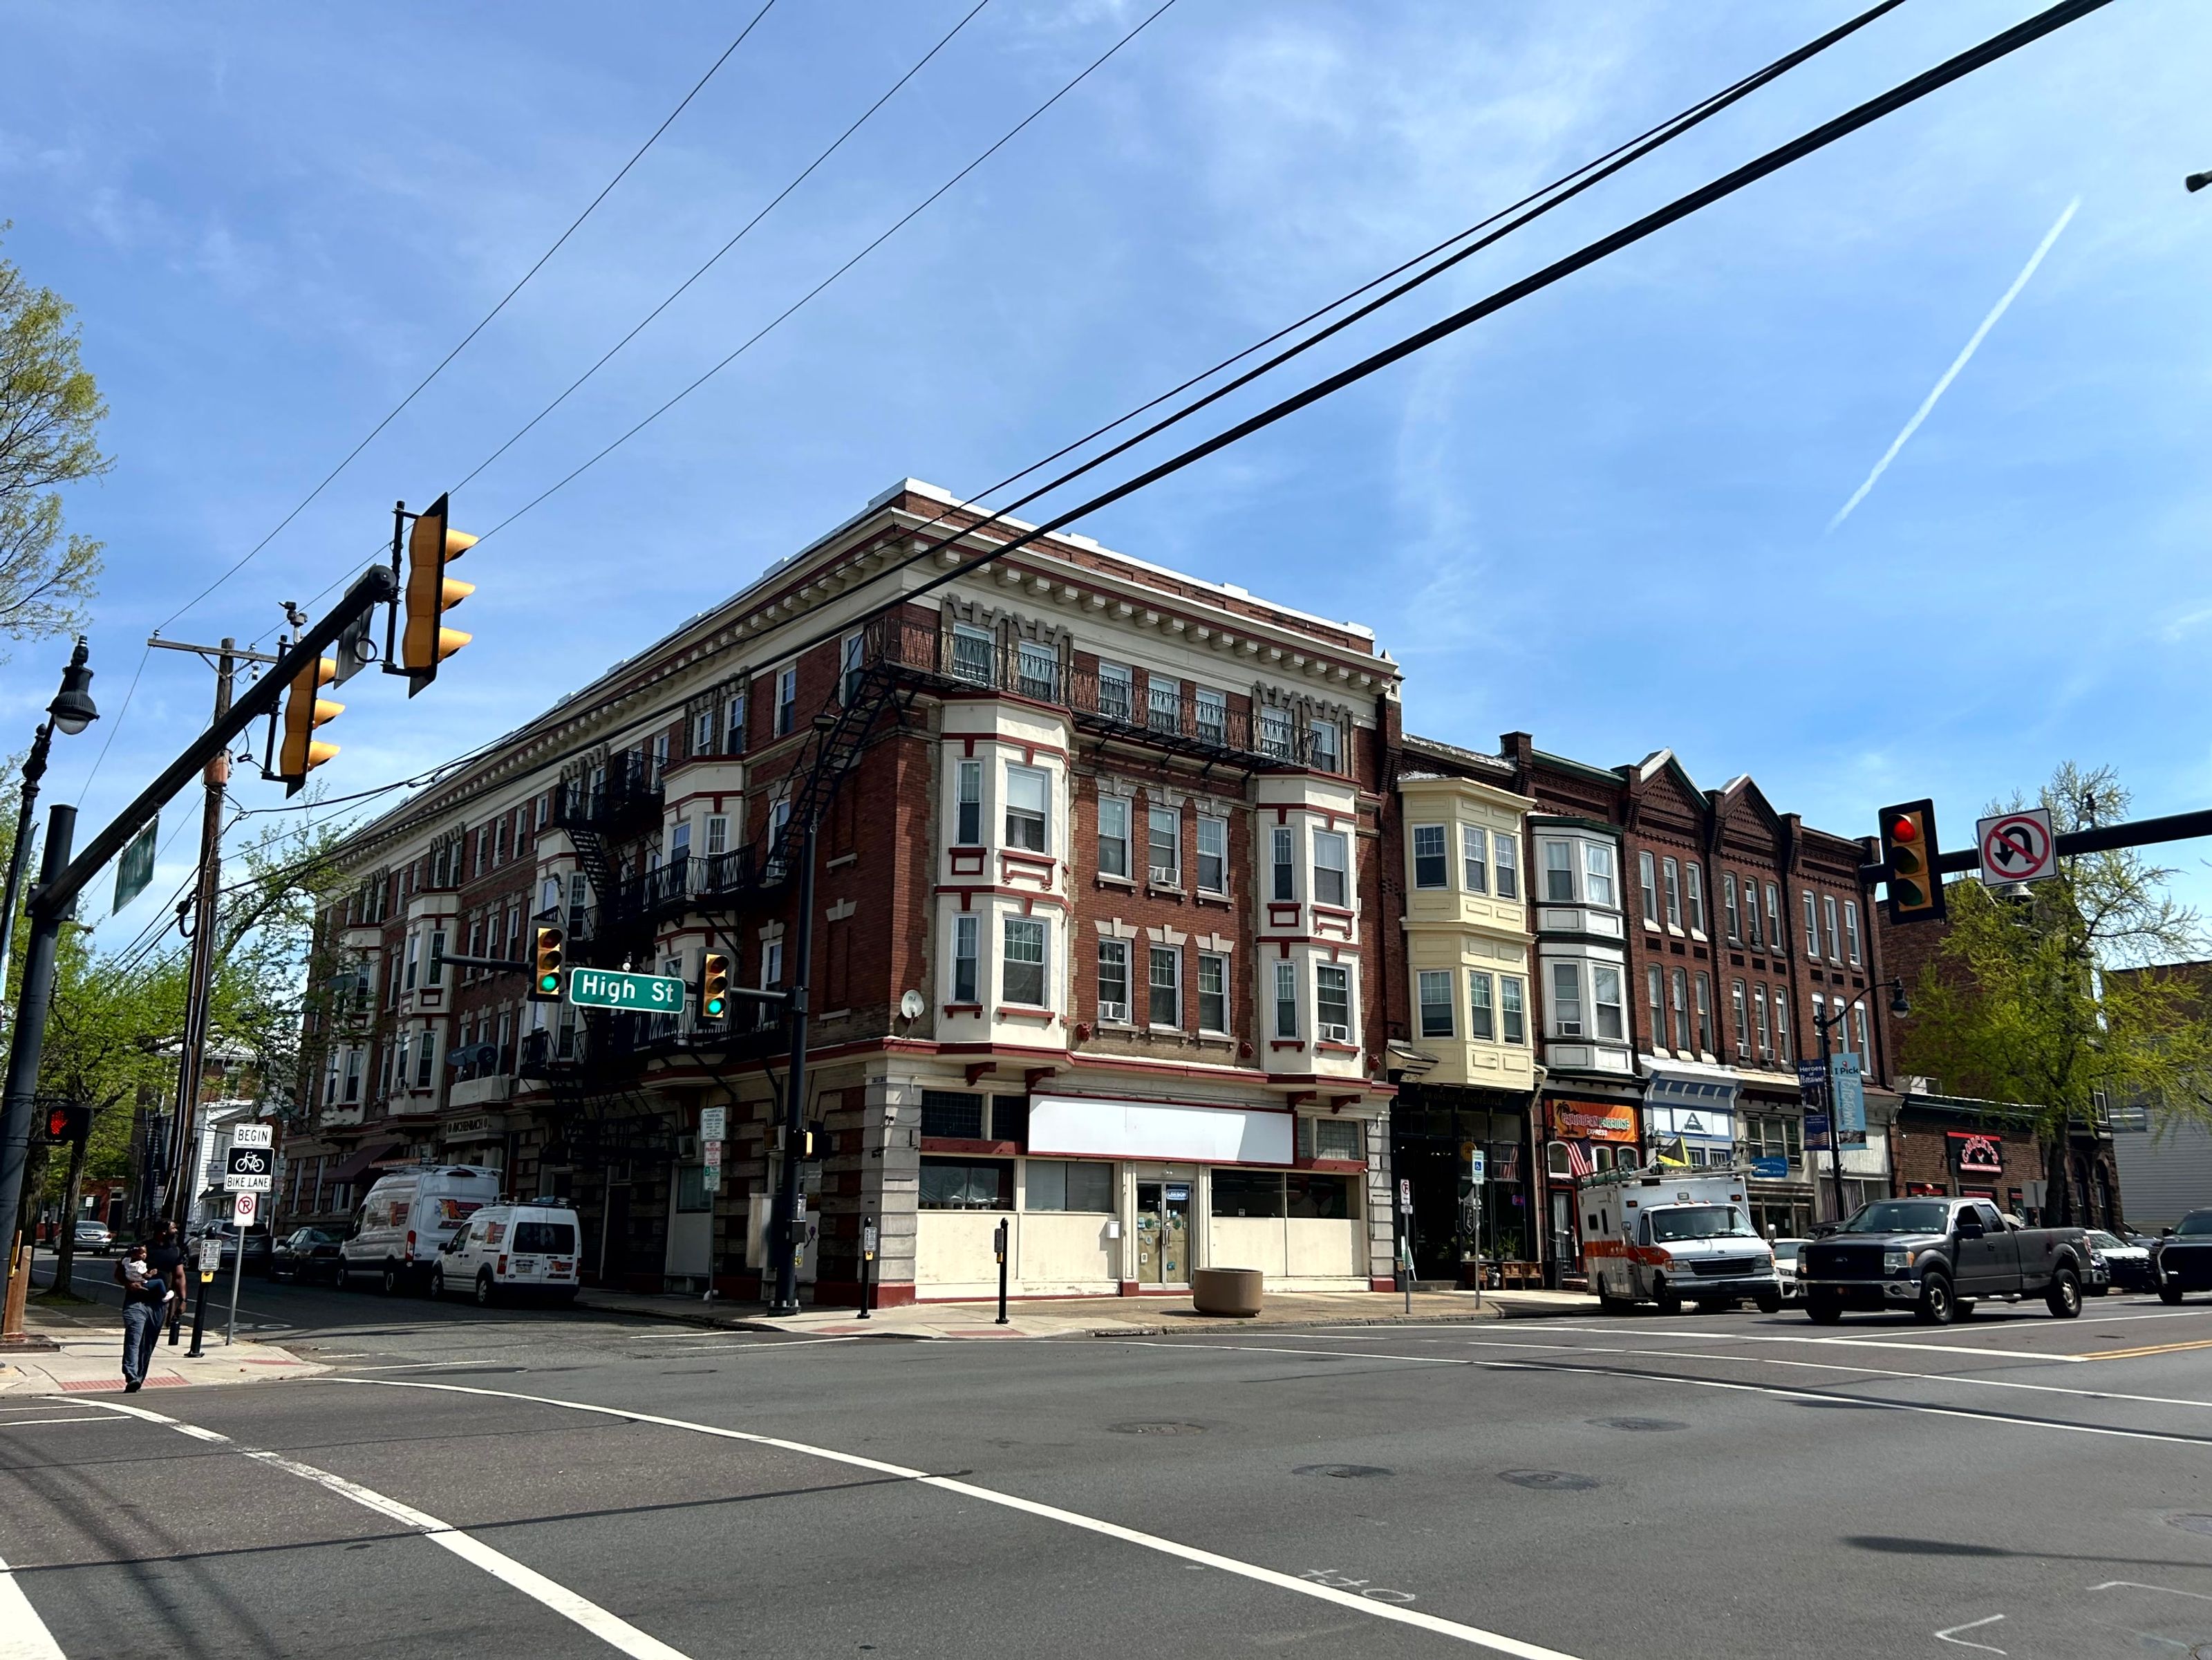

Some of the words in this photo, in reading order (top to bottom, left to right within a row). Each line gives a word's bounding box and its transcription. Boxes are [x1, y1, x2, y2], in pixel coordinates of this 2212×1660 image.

[582, 974, 635, 1004] High
[651, 981, 674, 1002] St
[1562, 1113, 1599, 1127] CARIBBEAN
[1598, 1117, 1631, 1130] PARADISE
[238, 1129, 268, 1142] BEGIN
[227, 1177, 245, 1187] BIKE
[247, 1177, 268, 1188] LANE
